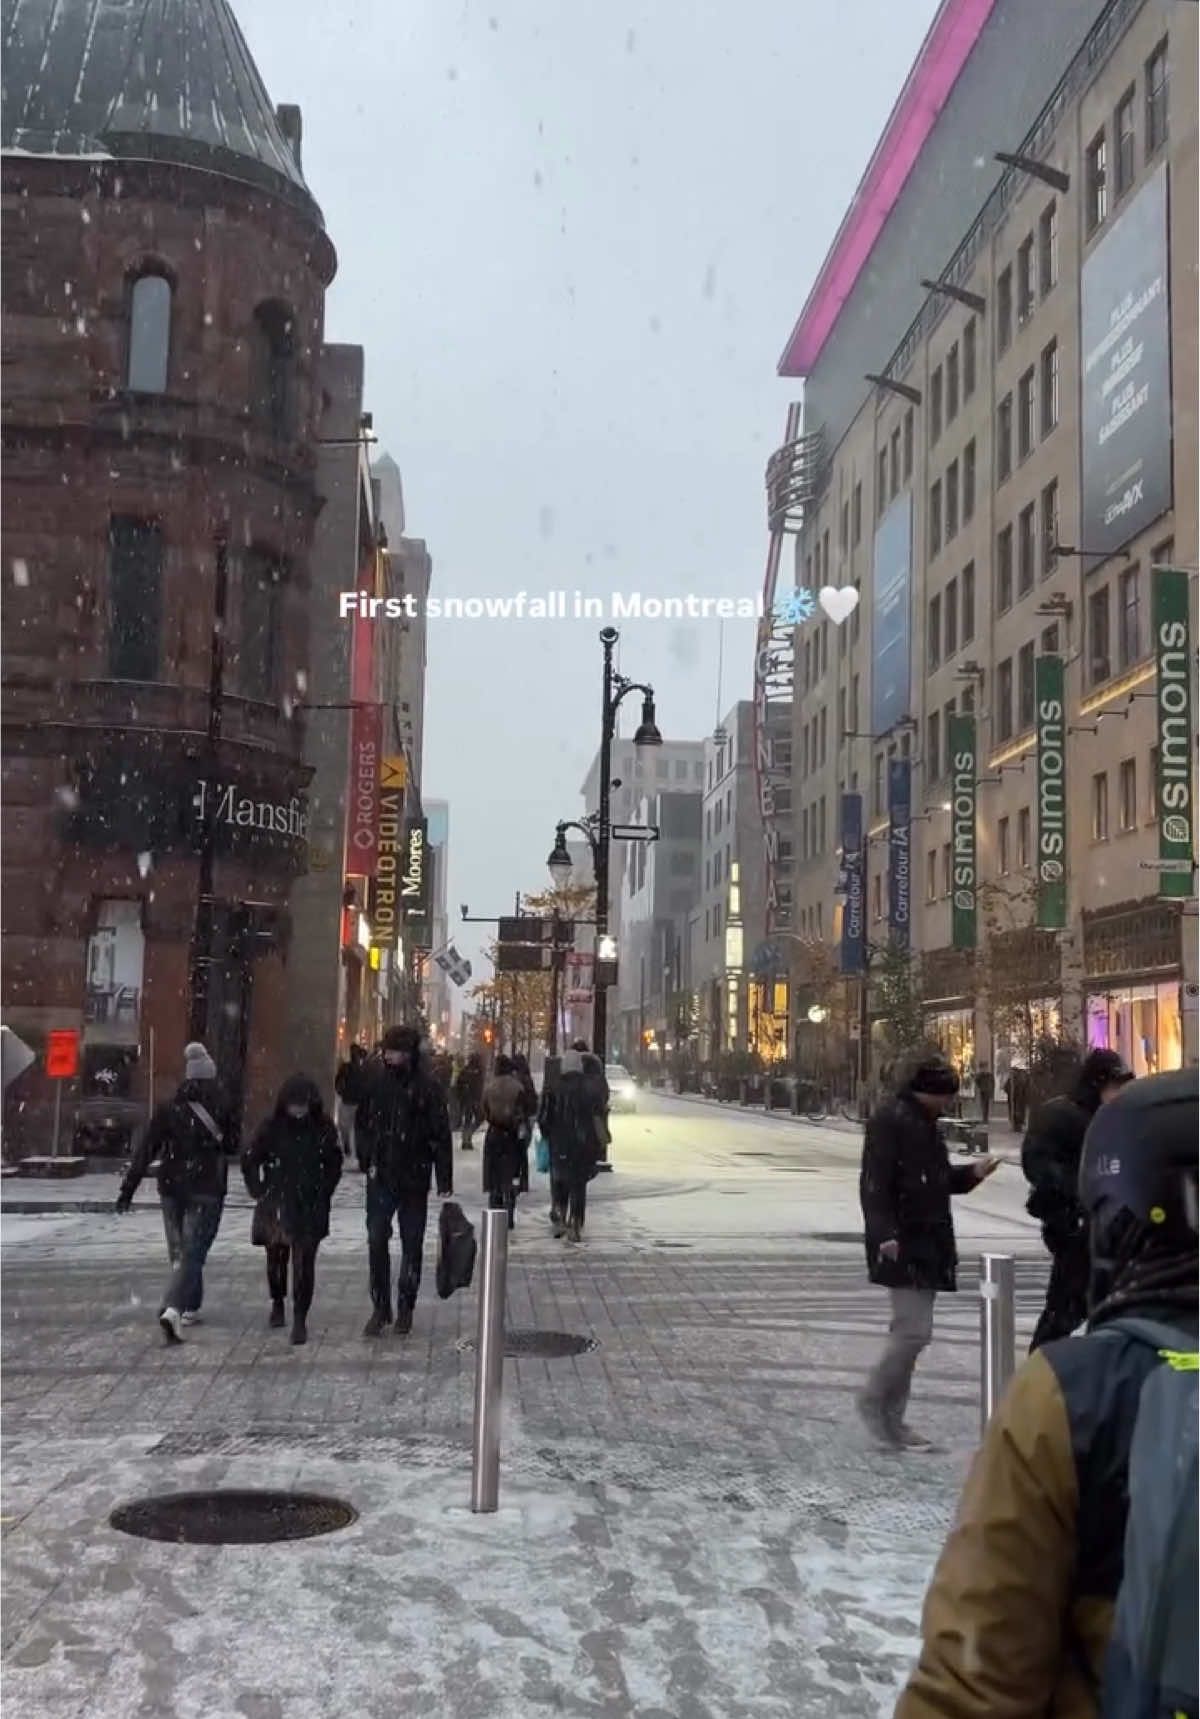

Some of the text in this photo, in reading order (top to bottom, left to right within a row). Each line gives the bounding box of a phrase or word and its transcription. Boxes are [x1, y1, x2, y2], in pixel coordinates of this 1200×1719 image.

[1160, 620, 1190, 810] simons
[357, 740, 376, 825] ROGERS
[954, 750, 974, 887] simons
[1040, 699, 1064, 856] simons
[401, 828, 423, 898] Moores
[895, 852, 909, 923] Carrefour
[848, 873, 863, 939] Carrefour
